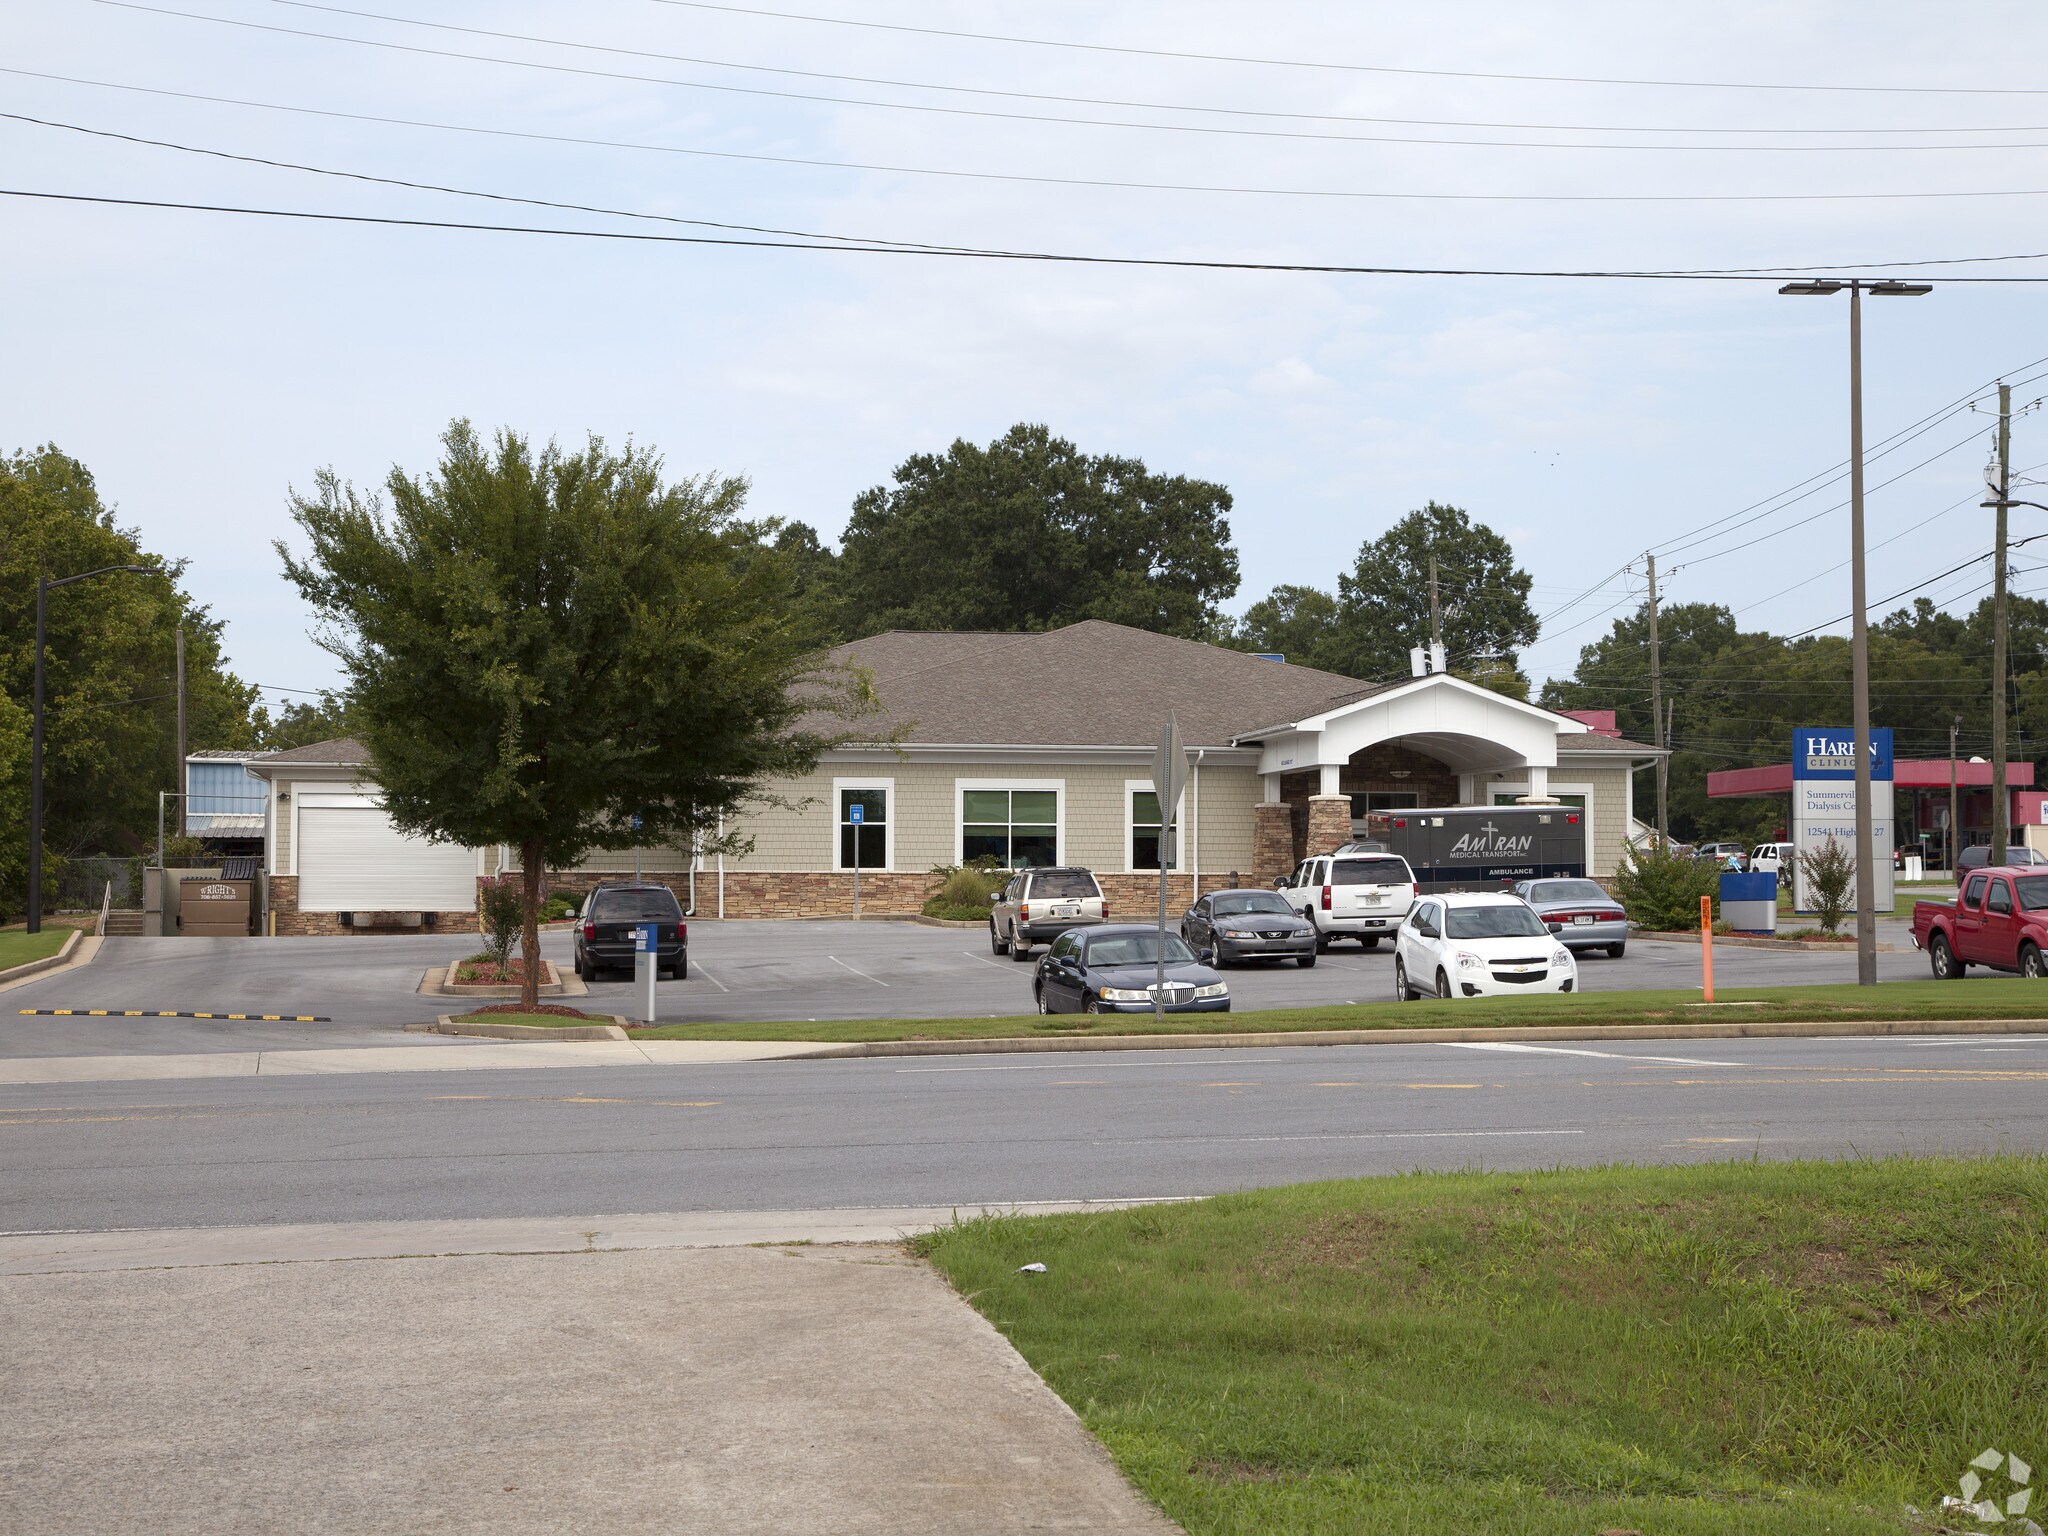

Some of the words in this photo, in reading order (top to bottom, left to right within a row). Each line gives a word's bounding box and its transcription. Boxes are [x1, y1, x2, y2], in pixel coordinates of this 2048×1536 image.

[1806, 738, 1878, 755] HARBN
[1810, 759, 1855, 767] CLINIC
[1806, 790, 1855, 799] Summervil
[1807, 801, 1841, 812] Dialysis
[1835, 827, 1856, 838] High
[1874, 827, 1884, 836] 27
[1482, 850, 1520, 858] TRANSPORT
[1488, 868, 1534, 876] AMBULANCE
